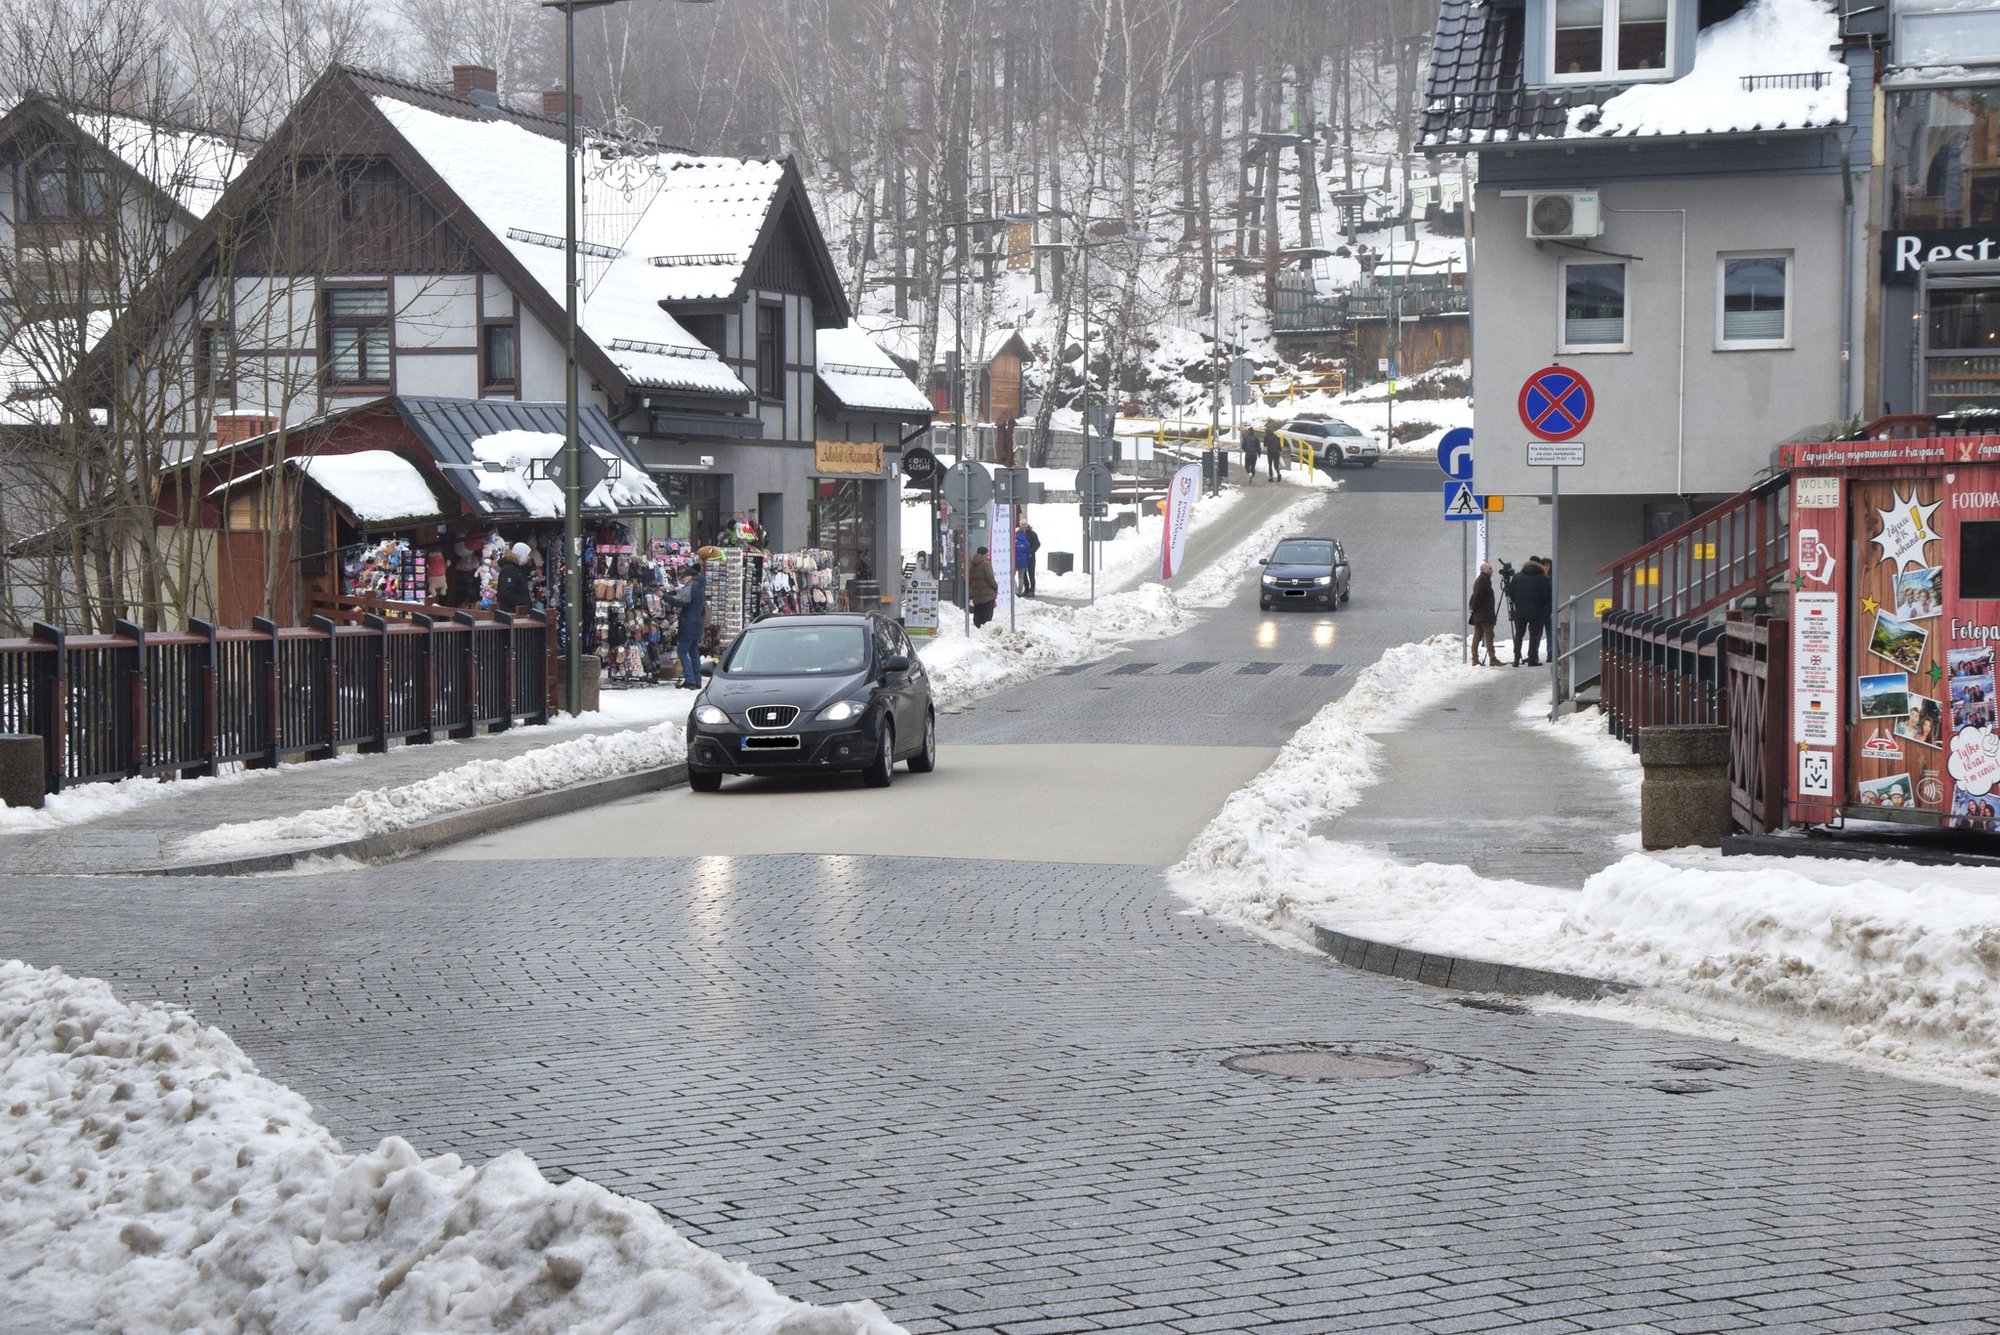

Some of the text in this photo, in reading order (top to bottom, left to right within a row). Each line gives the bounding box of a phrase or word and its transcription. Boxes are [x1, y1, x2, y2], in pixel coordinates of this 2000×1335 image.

[1896, 235, 2000, 272] Rest
[1905, 446, 1945, 460] Karpacza
[1800, 478, 1838, 489] WOLNE
[1797, 494, 1839, 506] ZAJĘTE
[1951, 618, 2000, 647] Fotopa
